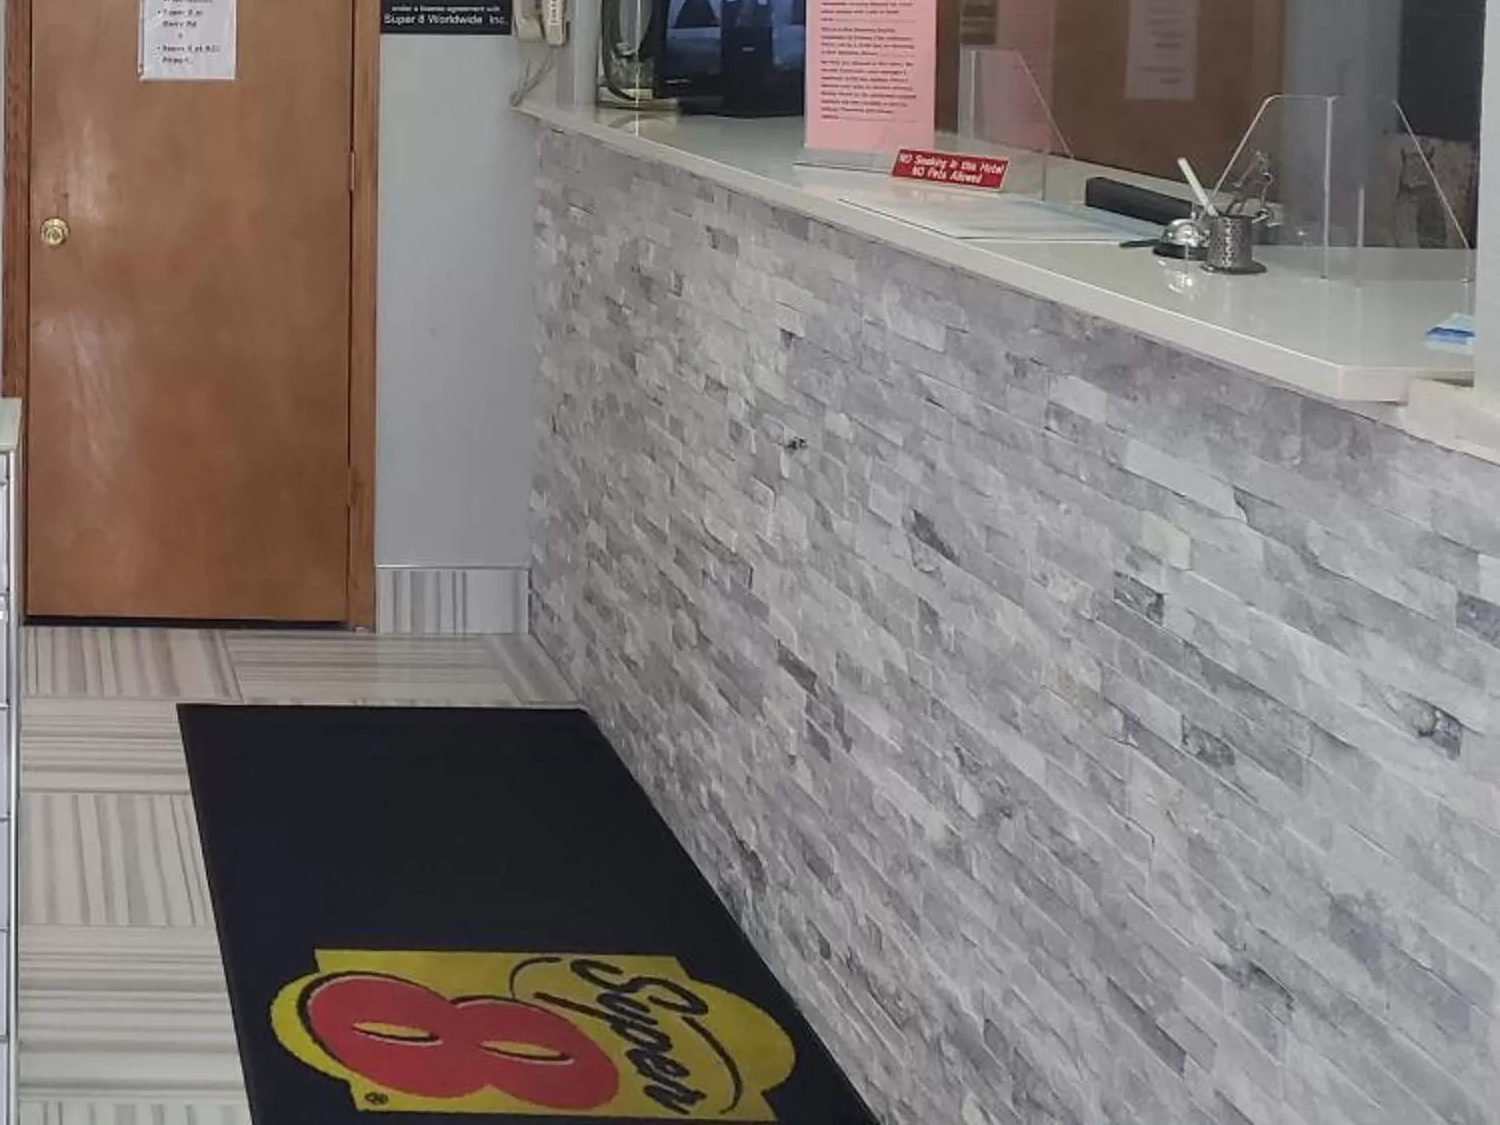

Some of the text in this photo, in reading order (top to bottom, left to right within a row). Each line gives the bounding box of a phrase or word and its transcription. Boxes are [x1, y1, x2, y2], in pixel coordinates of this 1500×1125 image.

[383, 13, 417, 26] Super
[899, 153, 913, 165] NO
[913, 155, 948, 171] Smoking
[979, 161, 1006, 175] Hotel
[911, 165, 984, 184] NO Pets Allowed
[299, 969, 620, 1110] 8
[533, 958, 710, 1116] Super
